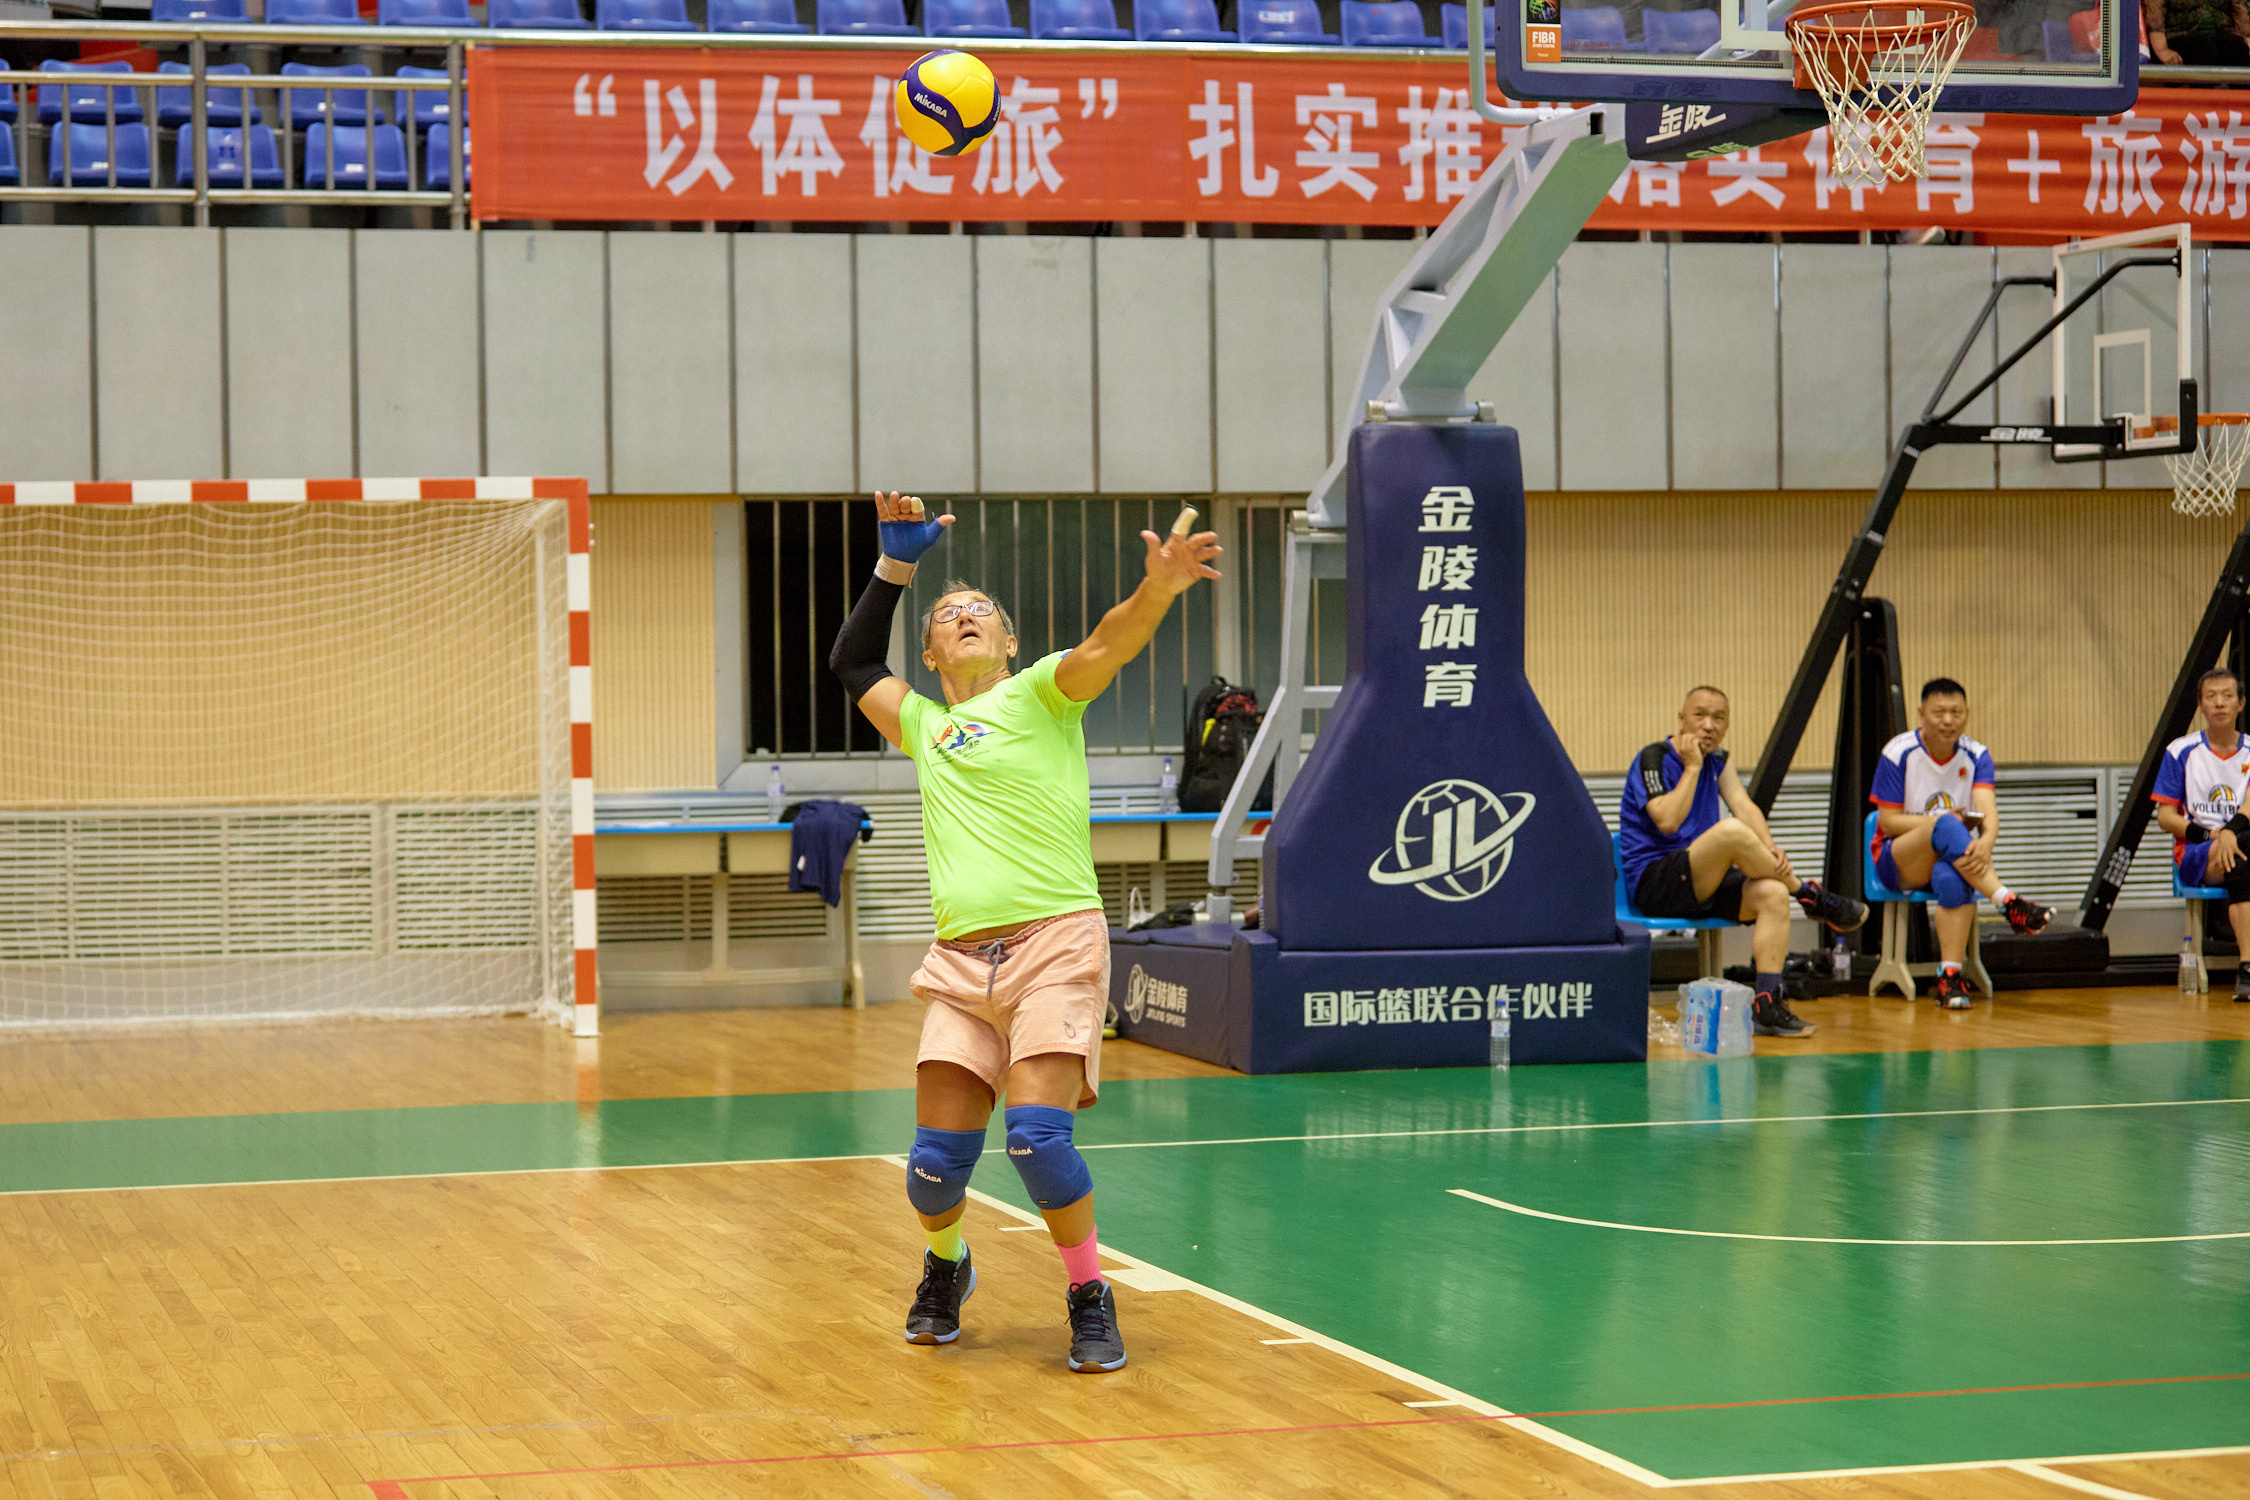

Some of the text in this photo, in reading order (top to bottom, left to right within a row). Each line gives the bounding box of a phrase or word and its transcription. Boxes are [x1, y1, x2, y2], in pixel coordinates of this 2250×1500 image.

[1532, 31, 1556, 44] FIBA
[1417, 485, 1480, 709] 金陵体育
[1303, 981, 1594, 1027] 国际篮联合作伙伴
